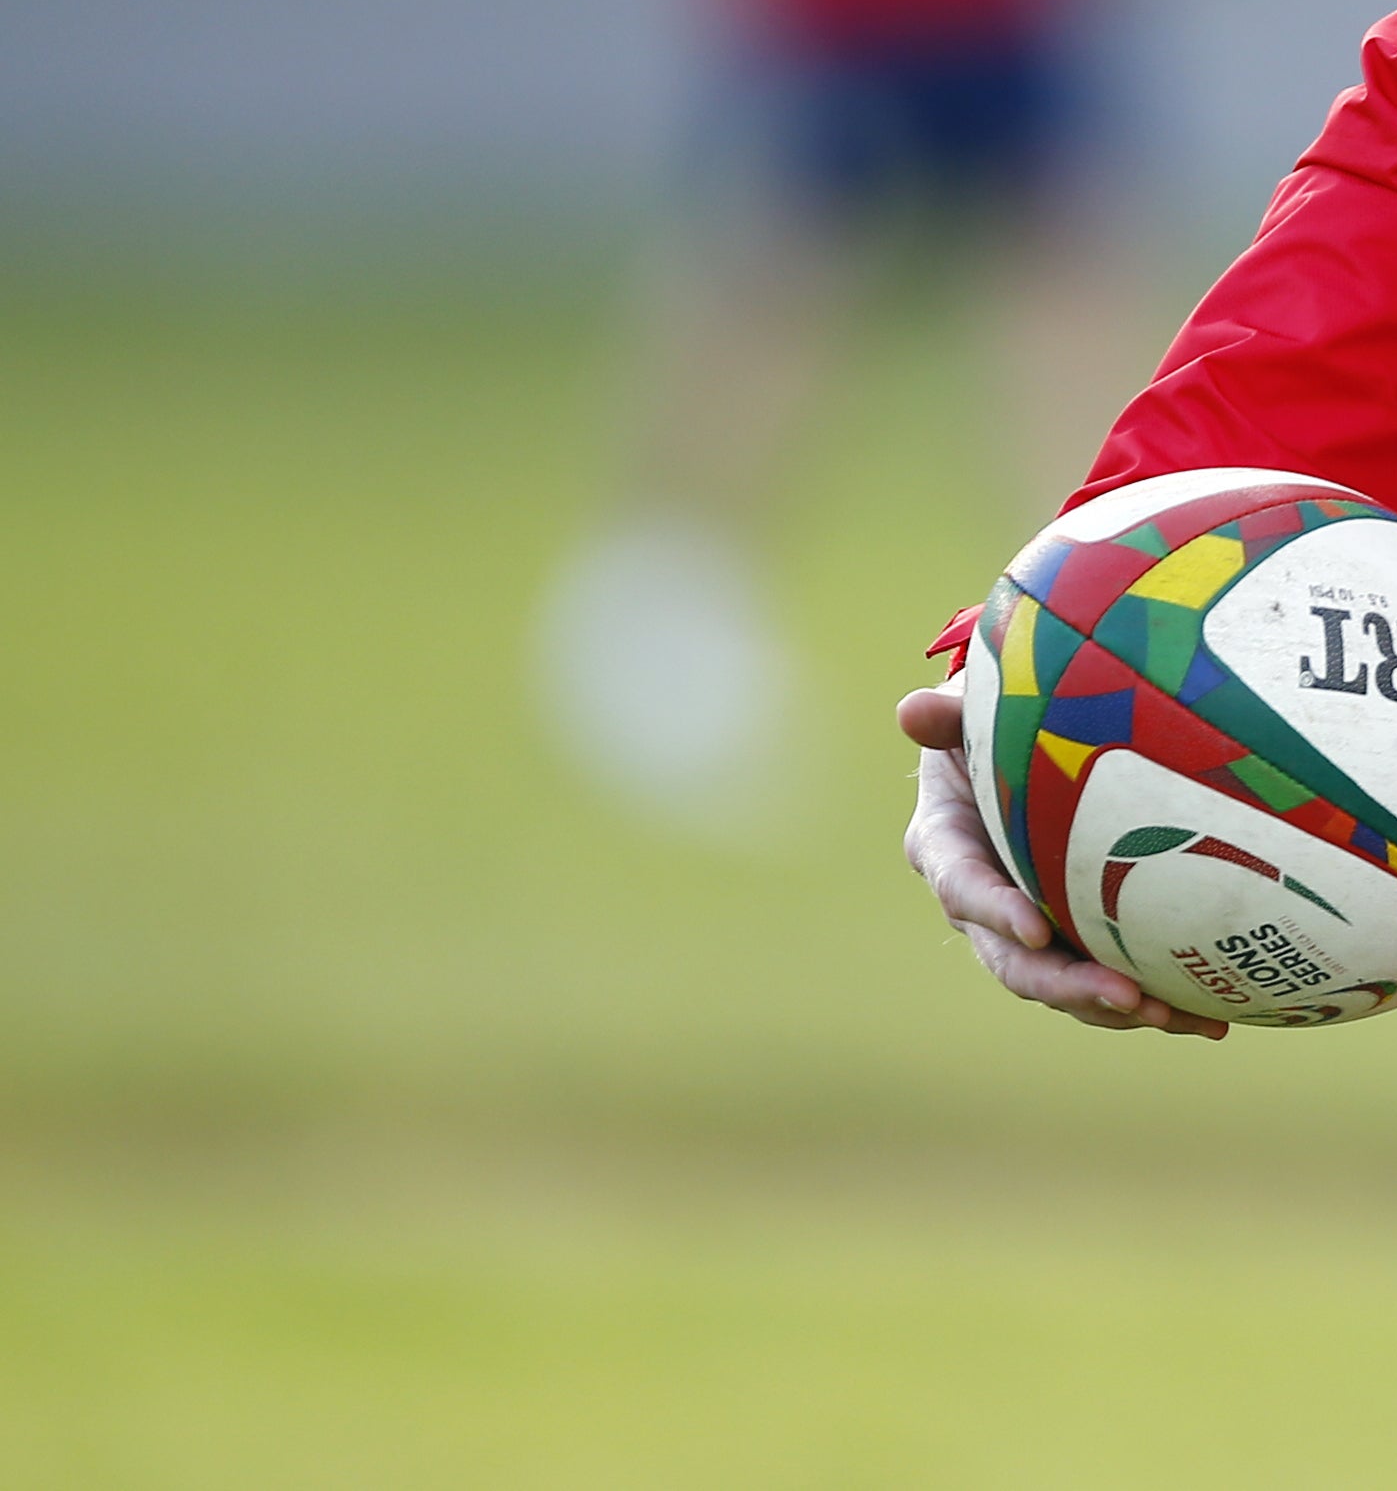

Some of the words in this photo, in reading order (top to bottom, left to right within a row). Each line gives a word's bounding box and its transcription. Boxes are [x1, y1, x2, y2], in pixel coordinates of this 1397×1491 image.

[1169, 945, 1250, 1003] CASTLE
[1215, 935, 1301, 997] LIONS
[1250, 923, 1331, 986] SERIES
